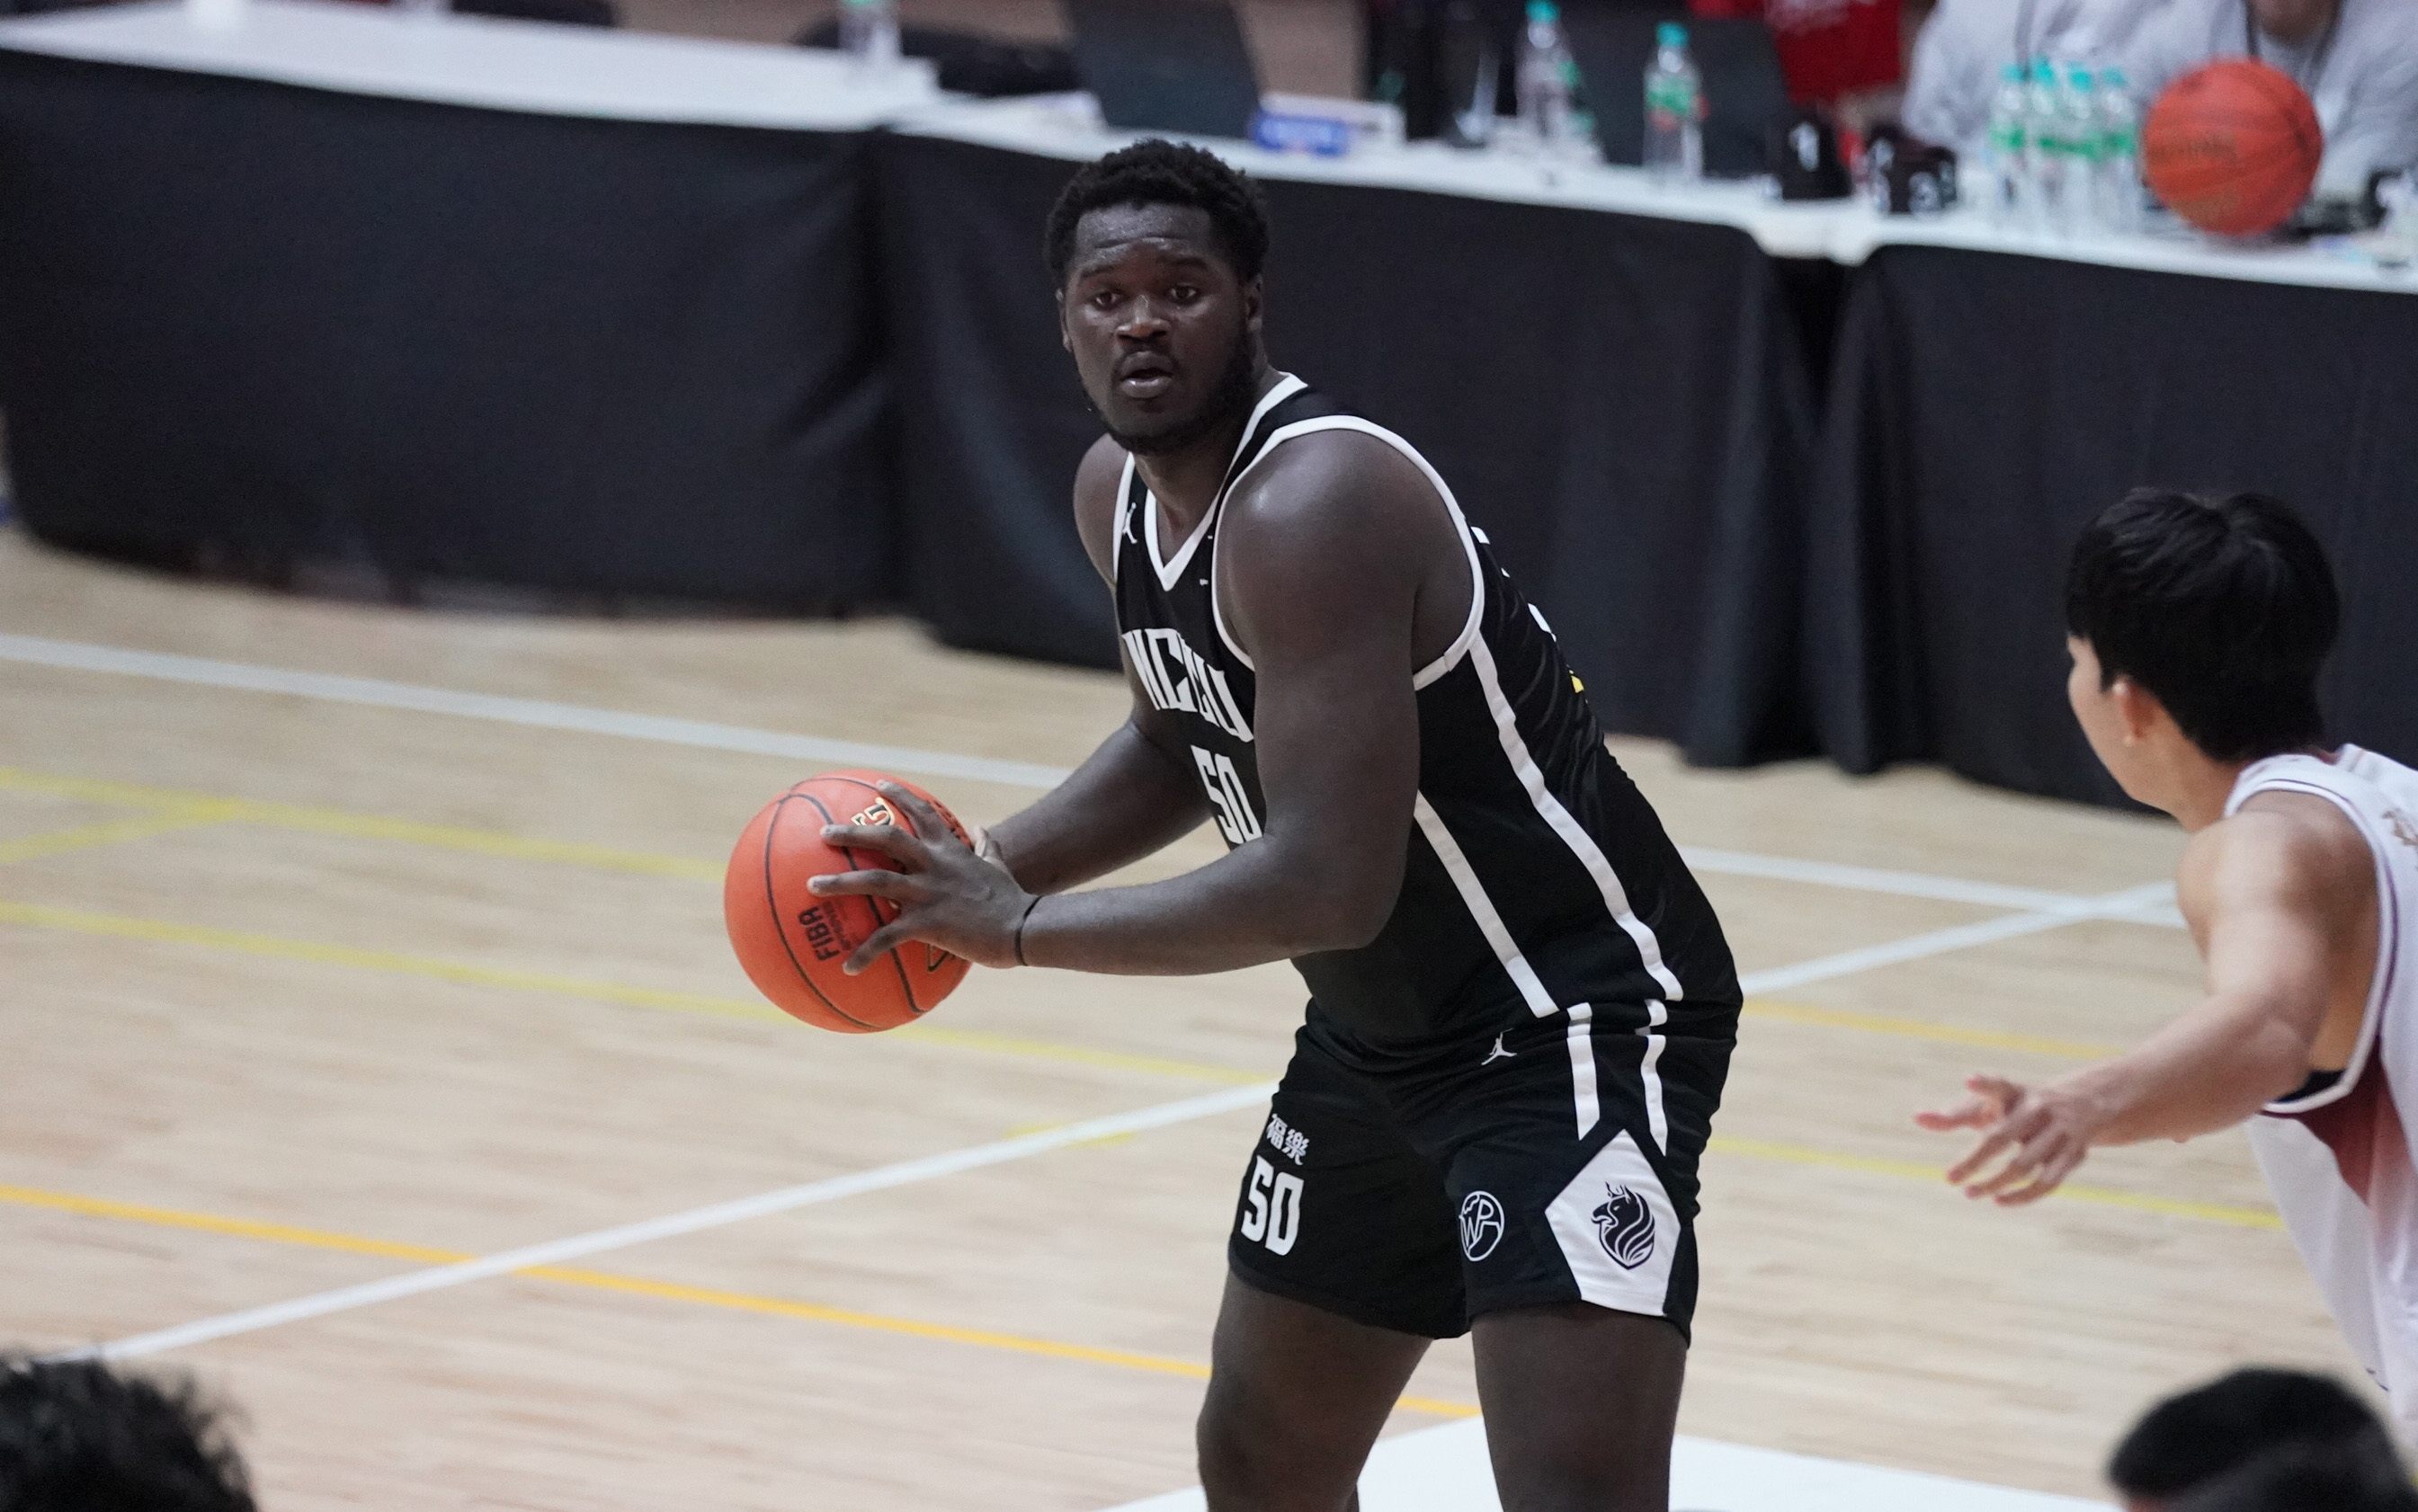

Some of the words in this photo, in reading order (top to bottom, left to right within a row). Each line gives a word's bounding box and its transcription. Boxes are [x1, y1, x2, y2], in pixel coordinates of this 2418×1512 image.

[1190, 743, 1263, 844] 50
[799, 905, 840, 961] FIBA
[1240, 1154, 1304, 1256] 50
